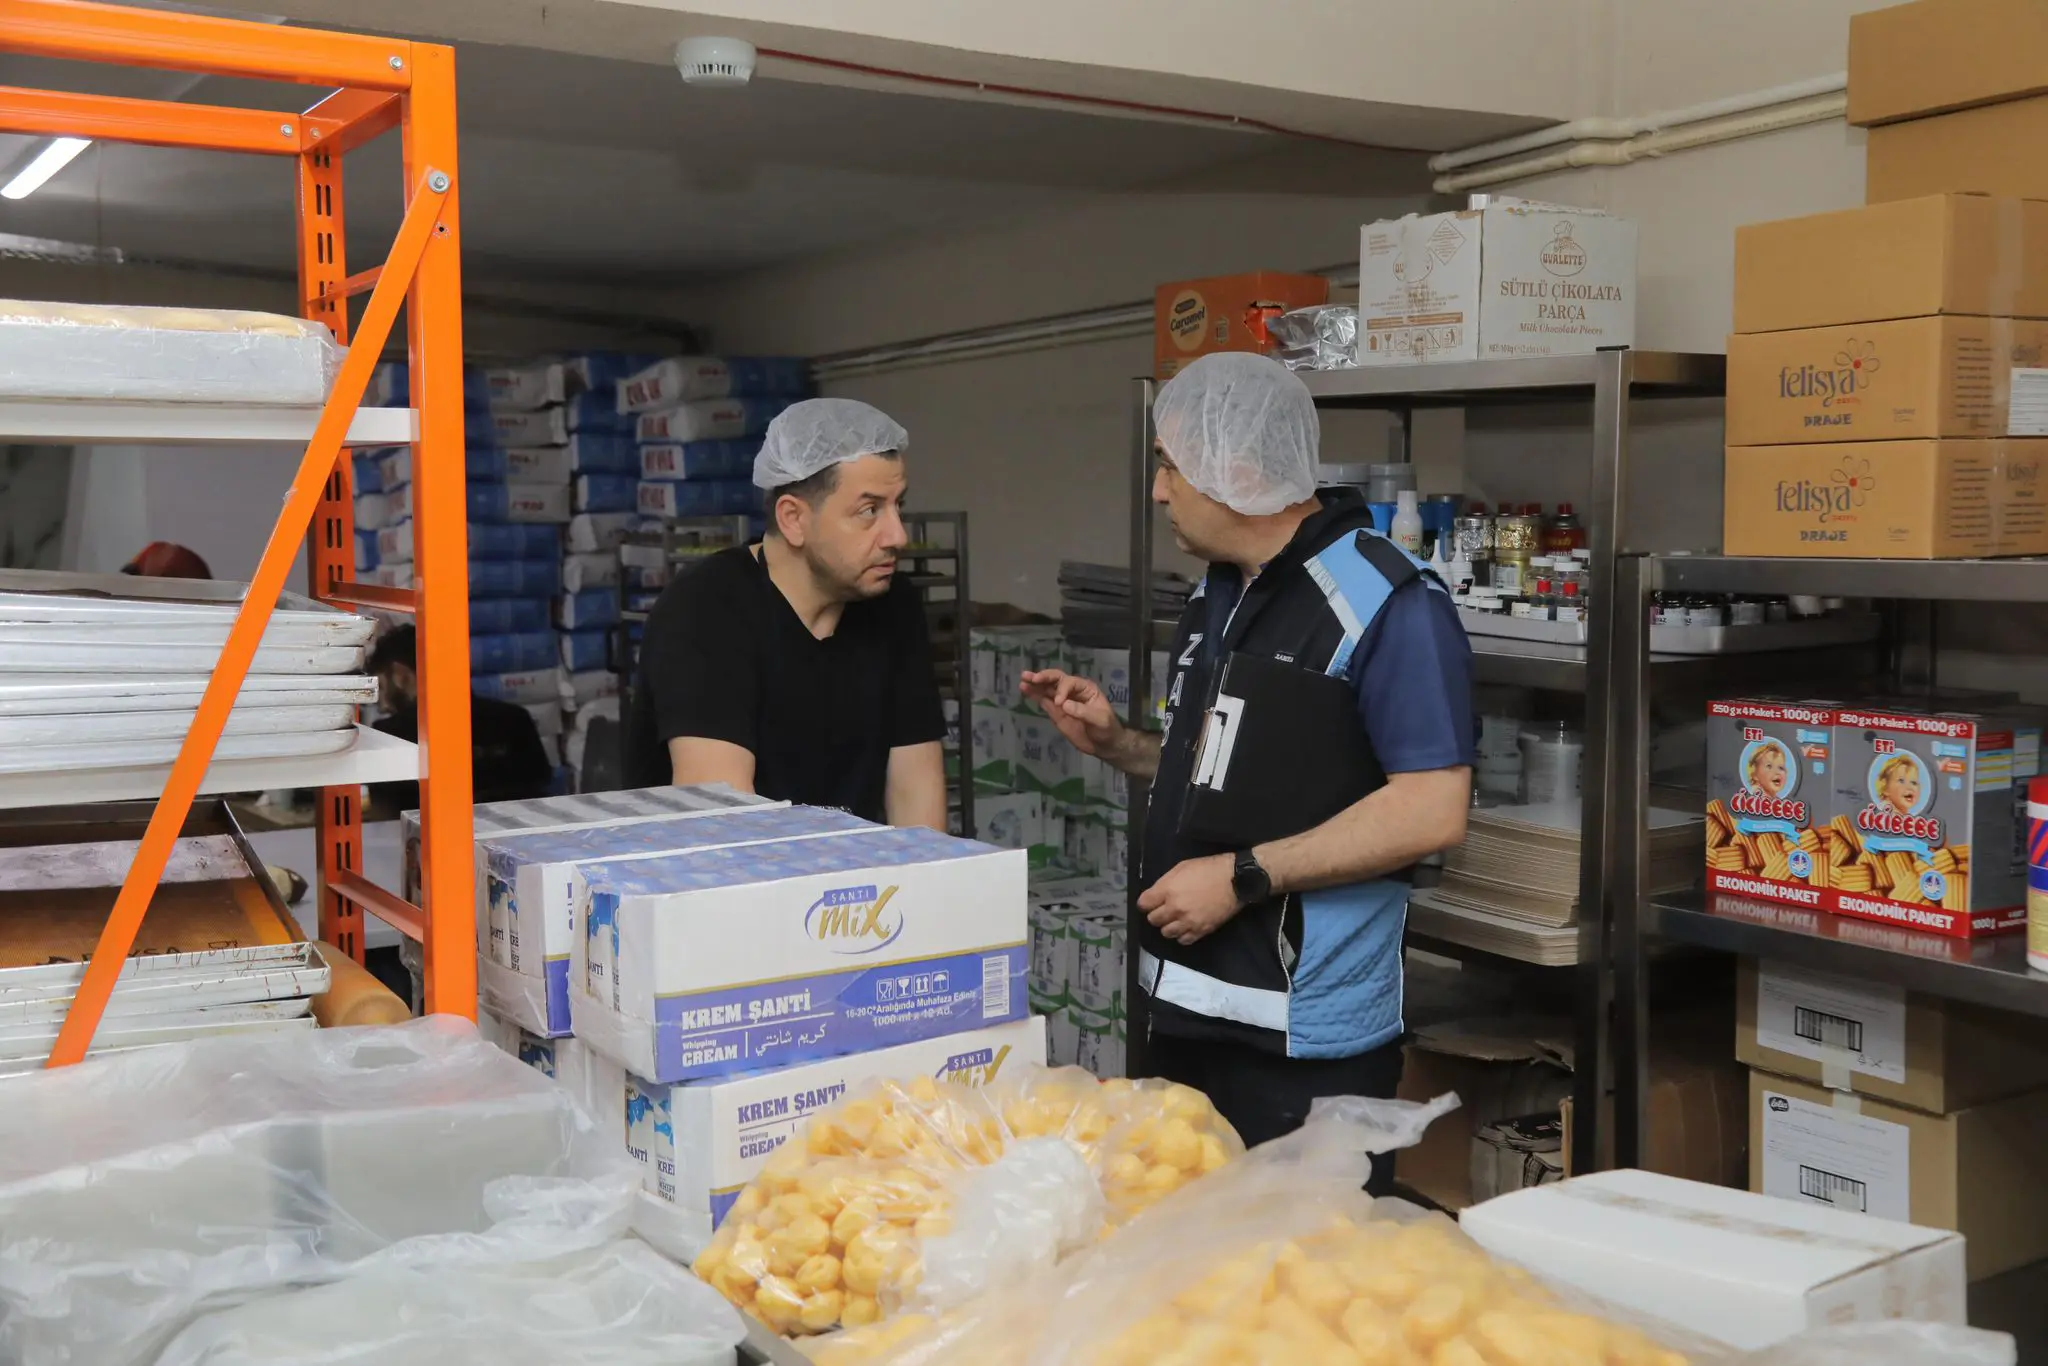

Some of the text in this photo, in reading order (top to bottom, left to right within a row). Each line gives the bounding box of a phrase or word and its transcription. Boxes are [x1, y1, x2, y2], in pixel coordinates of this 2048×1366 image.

[1500, 277, 1622, 302] SÜTLÜ ÇİKOLATA
[1537, 303, 1586, 323] PARÇA
[1519, 322, 1538, 333] Milk
[1539, 323, 1578, 334] Chocolate
[1779, 364, 1855, 408] felisya
[1803, 413, 1852, 427] DRAJE
[1774, 479, 1851, 523] felisya
[1800, 530, 1848, 542] DRAJE
[1712, 703, 1729, 714] 250
[1729, 706, 1736, 717] g
[1742, 706, 1749, 716] 4
[1749, 707, 1775, 718] Paket
[1782, 708, 1810, 721] 1000
[1840, 713, 1858, 724] 250
[1858, 717, 1865, 727] g
[1872, 716, 1879, 726] 4
[1879, 717, 1908, 729] Paket
[1916, 719, 1947, 733] 1000
[1715, 875, 1820, 905] EKONOMİK PAKET
[1838, 895, 1954, 930] EKONOMİK PAKET
[681, 987, 812, 1031] KREM ŞANTİ
[872, 1014, 896, 1027] 1000
[682, 1038, 717, 1051] Whipping
[755, 1022, 827, 1057] كريم شانتي
[682, 1043, 738, 1068] CREAM
[737, 1078, 846, 1125] KREM ŞANTİ
[739, 1131, 769, 1143] Whipping
[657, 1159, 675, 1176] KRE
